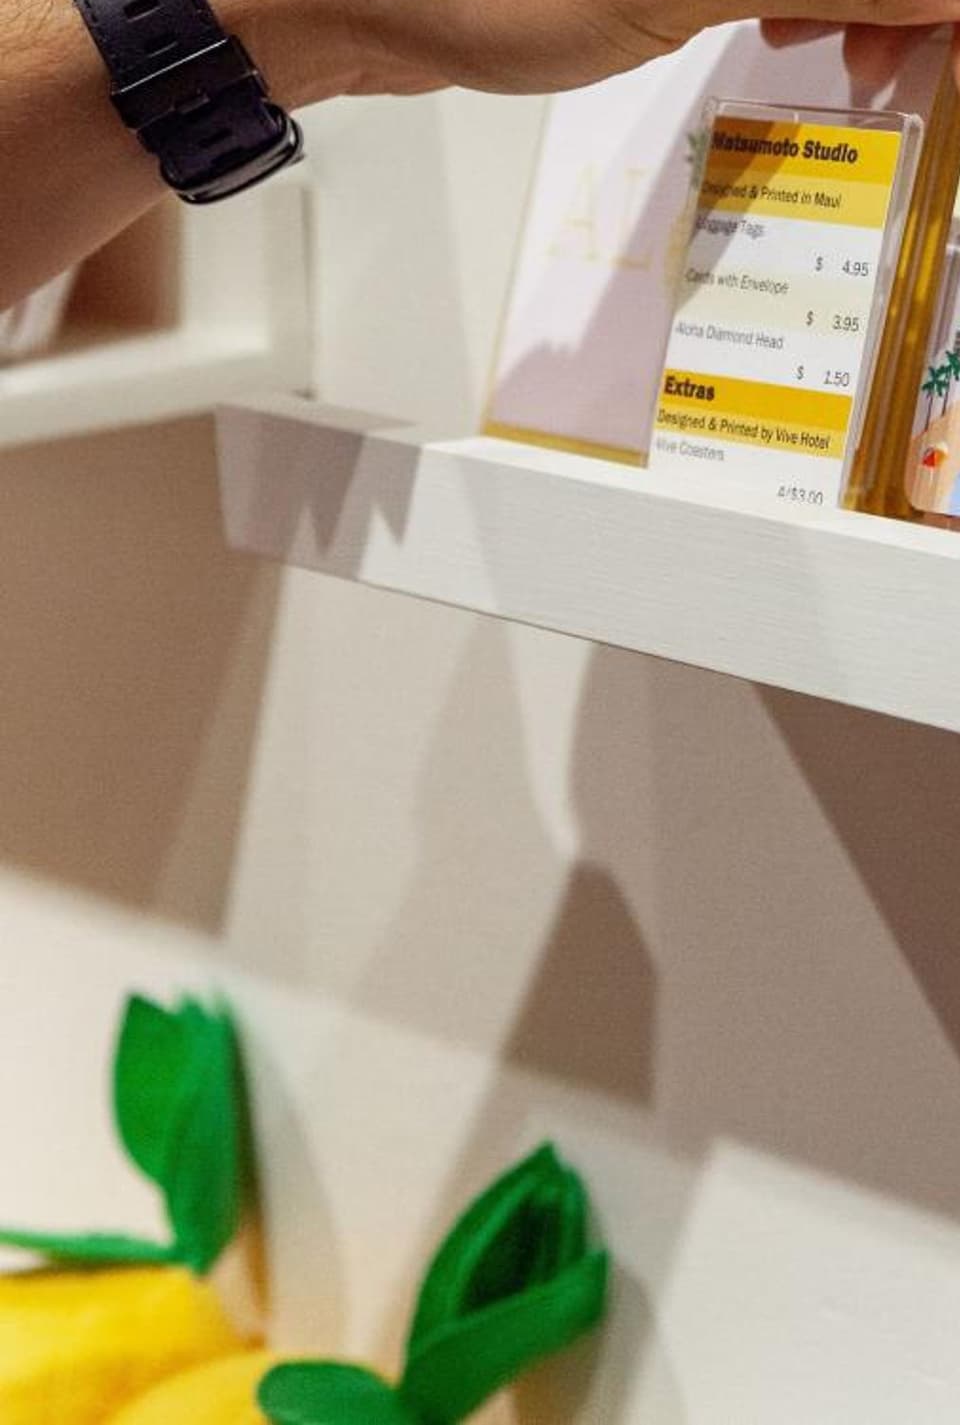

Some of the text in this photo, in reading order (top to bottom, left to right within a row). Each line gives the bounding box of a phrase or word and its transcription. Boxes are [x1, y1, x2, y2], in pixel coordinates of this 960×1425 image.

[711, 131, 859, 164] Matsumoto Studio
[749, 184, 758, 199] &
[760, 185, 799, 204] Printed
[801, 192, 812, 204] in
[814, 193, 842, 209] Maui
[815, 256, 870, 277] $ 4.95
[717, 274, 738, 288] with
[740, 274, 790, 295] Envelope
[806, 310, 860, 333] $ 3.95
[706, 323, 752, 346] Diamond
[753, 334, 785, 351] Head
[663, 375, 716, 402] Extras
[796, 365, 850, 388] $ 1.50
[656, 407, 832, 451] Designed & Printed by Vive Hotel
[679, 441, 725, 462] Coasters
